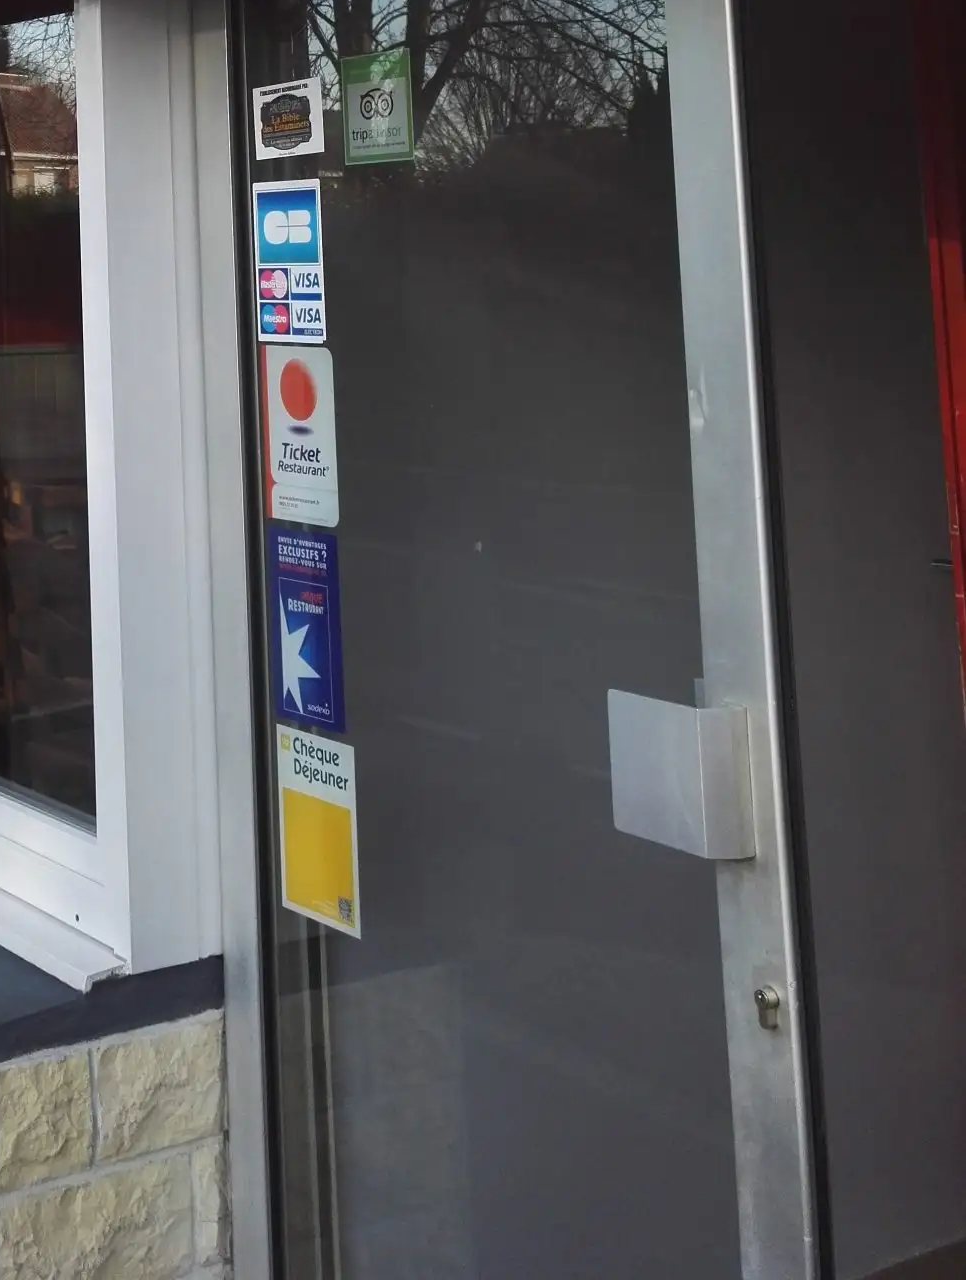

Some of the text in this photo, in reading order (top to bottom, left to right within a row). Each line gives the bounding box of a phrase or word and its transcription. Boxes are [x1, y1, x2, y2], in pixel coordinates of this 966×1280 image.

[294, 272, 320, 288] VISA
[263, 307, 322, 324] Maestro VISA
[281, 442, 322, 464] Ticket
[278, 544, 319, 561] EXCLUSIFS
[316, 562, 327, 570] SUR
[287, 598, 324, 615] RESTAURANT
[292, 736, 339, 767] Chèque
[293, 758, 349, 791] Déjeuner
